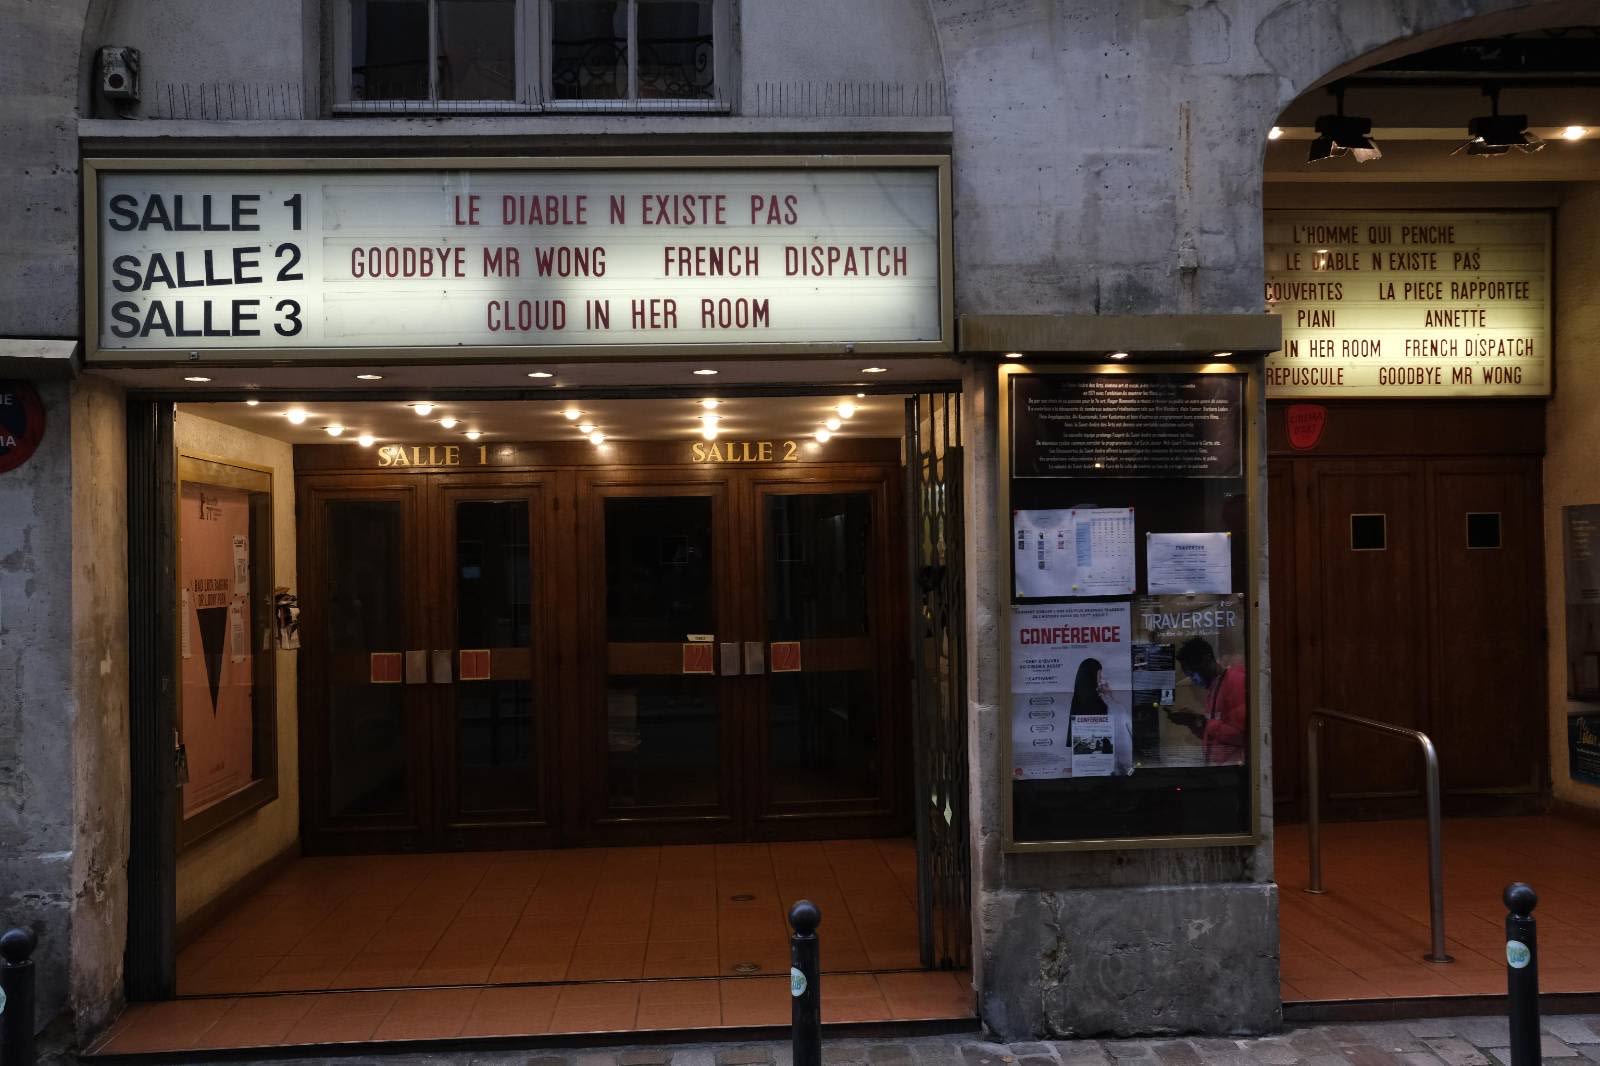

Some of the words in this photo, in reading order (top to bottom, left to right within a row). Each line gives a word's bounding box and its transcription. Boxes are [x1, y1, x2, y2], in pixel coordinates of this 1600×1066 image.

[108, 193, 260, 232] SALLE
[283, 193, 302, 231] 1
[455, 195, 481, 226] LE
[503, 195, 587, 226] DIABLE
[610, 195, 625, 225] N
[642, 195, 726, 225] EXISTE
[751, 195, 798, 225] PAS
[1294, 226, 1358, 244] L'HOMME
[1369, 226, 1391, 244] QUI
[1402, 226, 1455, 244] PENCHE
[112, 246, 262, 293] SALLE
[274, 243, 304, 282] 2
[351, 246, 465, 279] GOODBYE
[484, 246, 520, 278] MR
[536, 246, 606, 278] WONG
[664, 246, 759, 278] FRENCH
[785, 246, 907, 277] DISPATCH
[1287, 252, 1301, 271] LE
[1372, 252, 1382, 271] N
[1389, 252, 1438, 271] EXISTE
[1454, 252, 1480, 271] PAS
[1379, 282, 1395, 301] LA
[1404, 282, 1443, 301] PIECE
[1451, 282, 1529, 301] RAPPORTEE
[111, 300, 260, 339] SALLE
[274, 299, 303, 338] 3
[488, 300, 566, 332] CLOUD
[586, 299, 610, 330] IN
[632, 299, 677, 330] HER
[701, 298, 770, 329] ROOM
[1297, 309, 1336, 328] PIANI
[1425, 309, 1487, 328] ANNETTE
[1284, 339, 1298, 358] IN
[1310, 339, 1335, 358] HER
[1342, 339, 1381, 358] ROOM
[1405, 339, 1457, 358] FRENCH
[1466, 339, 1533, 358] DISPATCH
[1379, 367, 1441, 386] GOODBYE
[1452, 367, 1473, 385] MR
[1483, 367, 1521, 385] WONG
[378, 445, 460, 466] SALLE
[478, 445, 488, 465] 1
[692, 442, 773, 462] SALLE
[784, 440, 798, 461] 2
[1141, 610, 1236, 630] TRAVERSER
[1020, 624, 1121, 645] CONFÉRENCE
